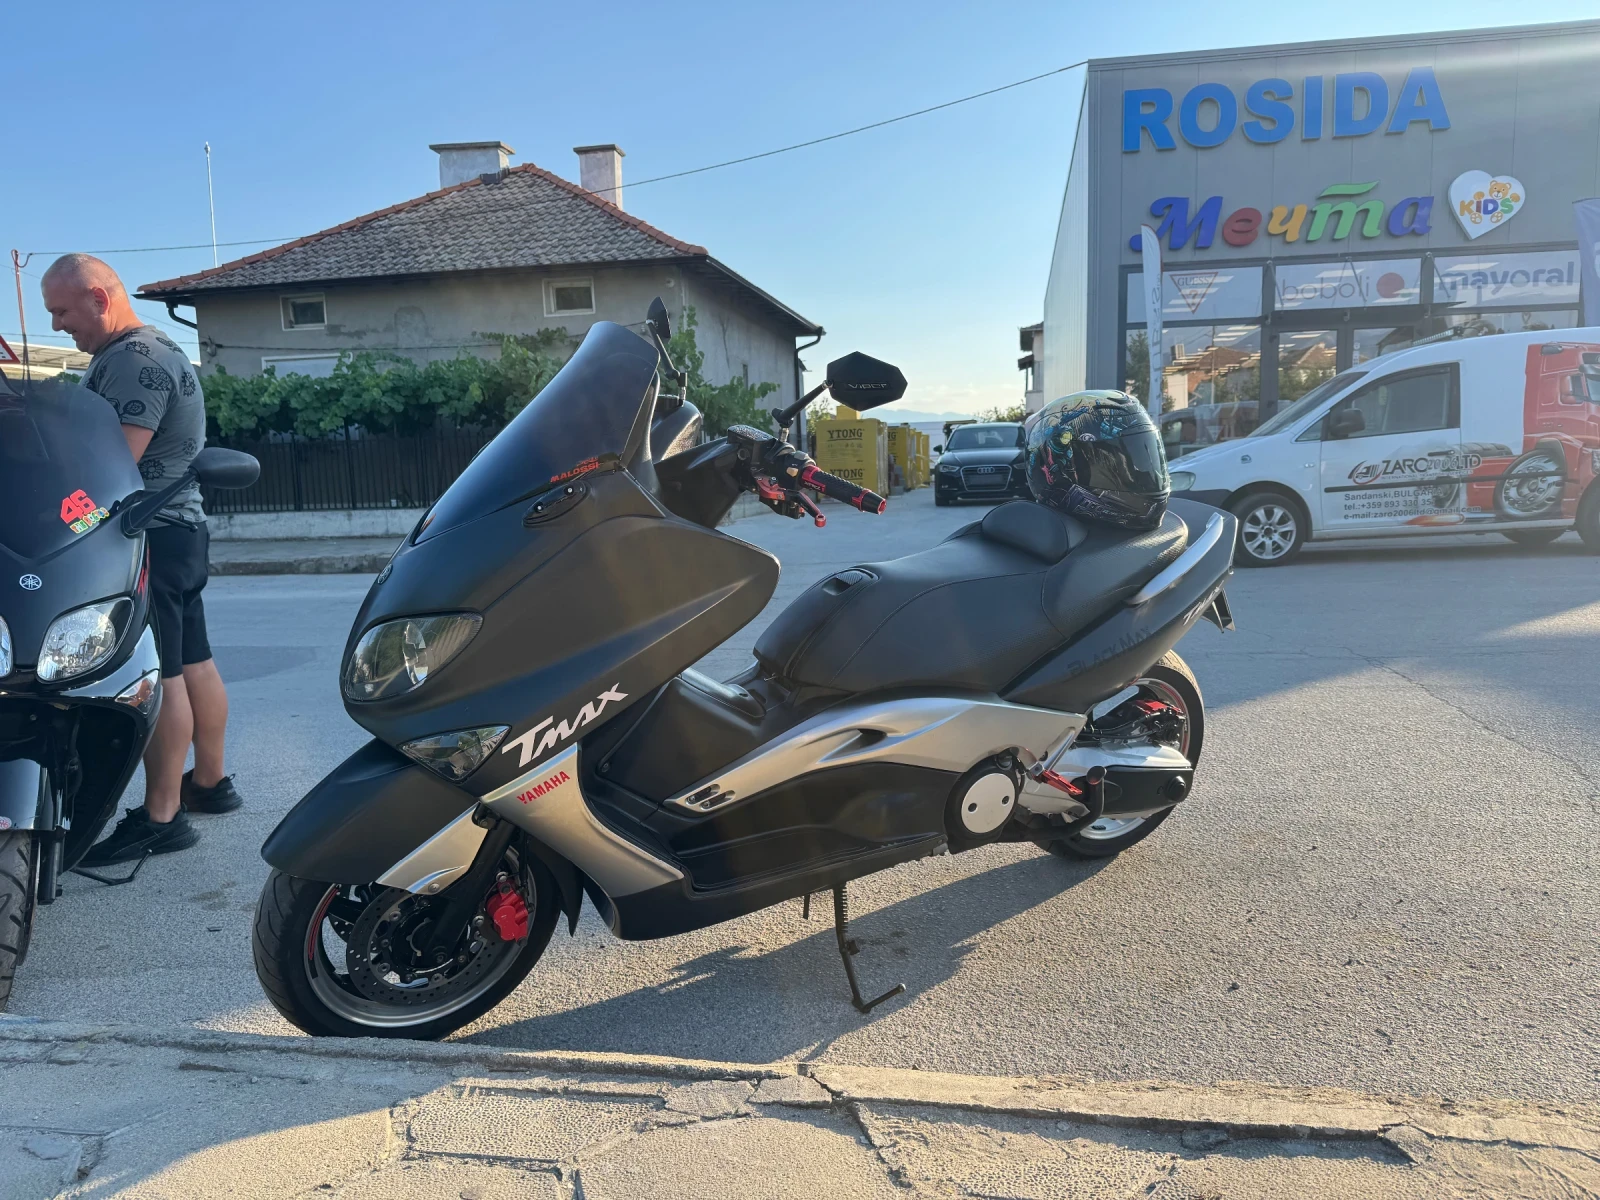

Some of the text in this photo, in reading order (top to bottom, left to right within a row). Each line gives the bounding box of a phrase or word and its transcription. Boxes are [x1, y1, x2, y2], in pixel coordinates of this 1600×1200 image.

[1122, 66, 1451, 153] ROSIDA
[1459, 196, 1514, 217] KIDS
[1177, 276, 1210, 287] GUESS
[1282, 275, 1370, 301] boboli
[1438, 261, 1575, 296] mayoral
[827, 428, 864, 439] YTONG
[550, 462, 600, 483] MALOSSI
[830, 468, 864, 479] YTONG
[60, 489, 97, 525] 46
[1384, 501, 1400, 509] 893
[1402, 499, 1419, 507] 330
[516, 770, 571, 805] YAMAHA
